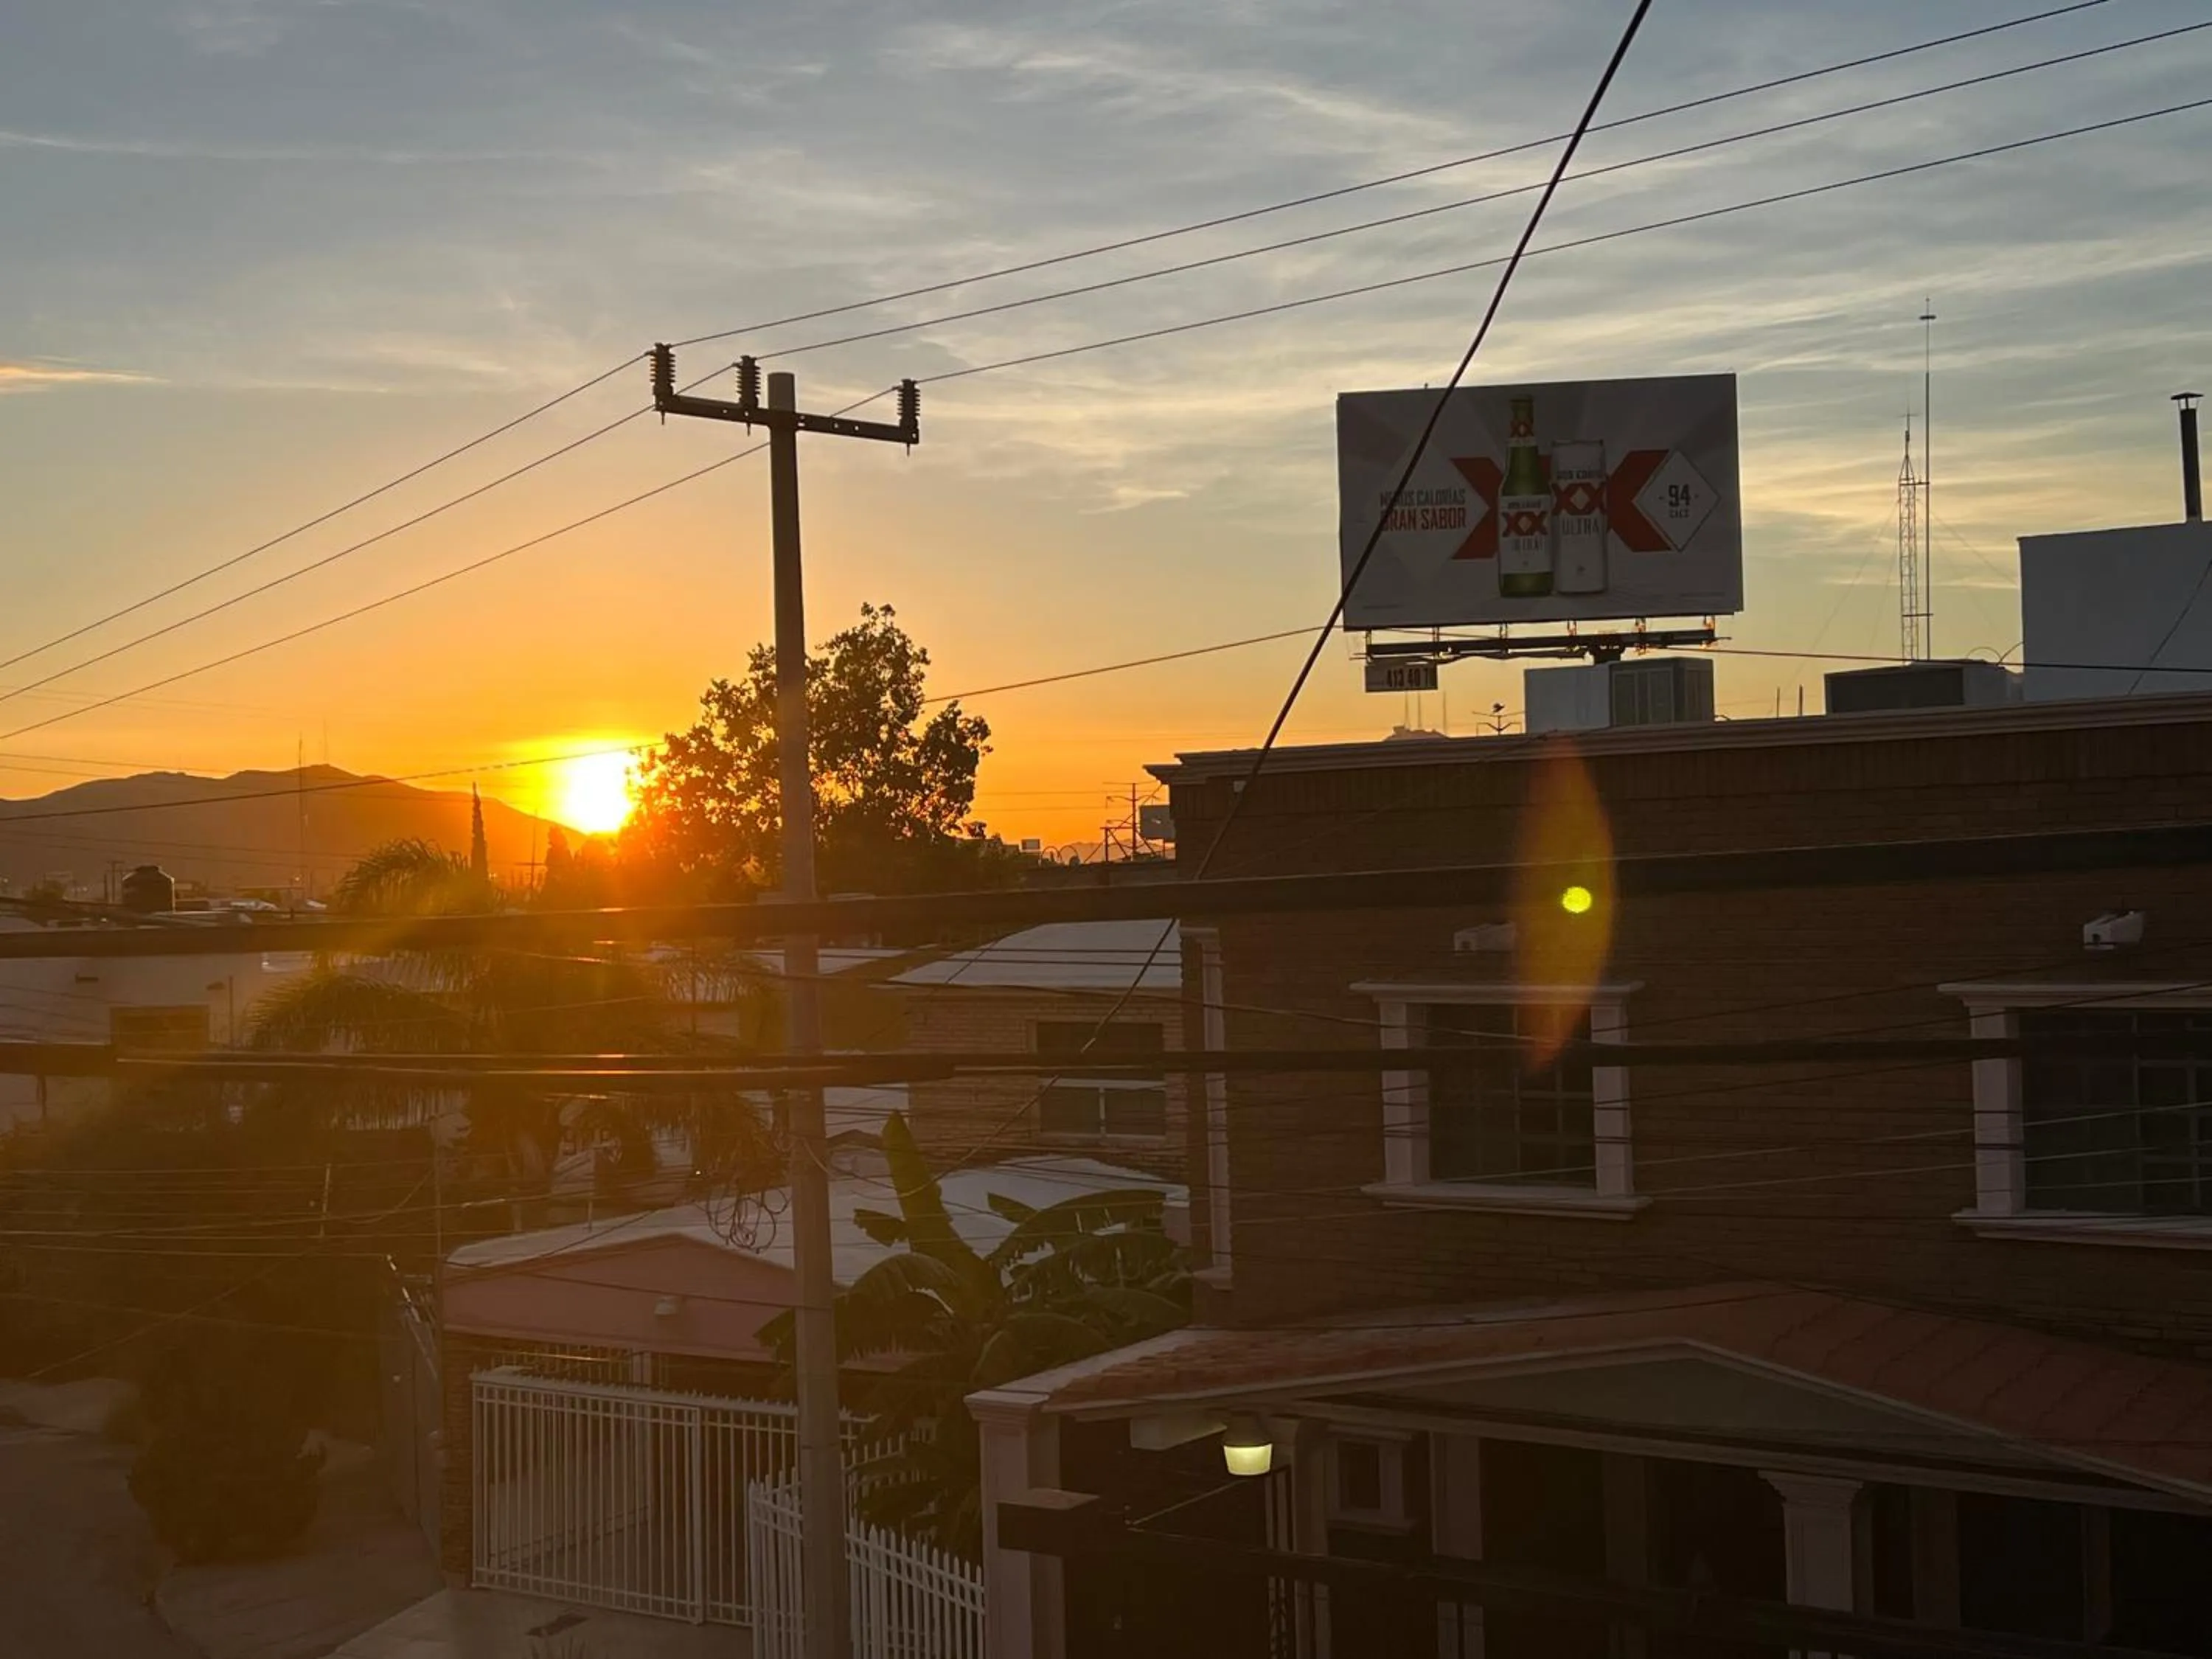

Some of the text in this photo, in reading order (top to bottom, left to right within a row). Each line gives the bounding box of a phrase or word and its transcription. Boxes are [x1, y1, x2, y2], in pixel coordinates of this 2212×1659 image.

[1669, 483, 1691, 507] 94
[1420, 507, 1467, 530] SABOR
[1562, 518, 1600, 537] ULTRA
